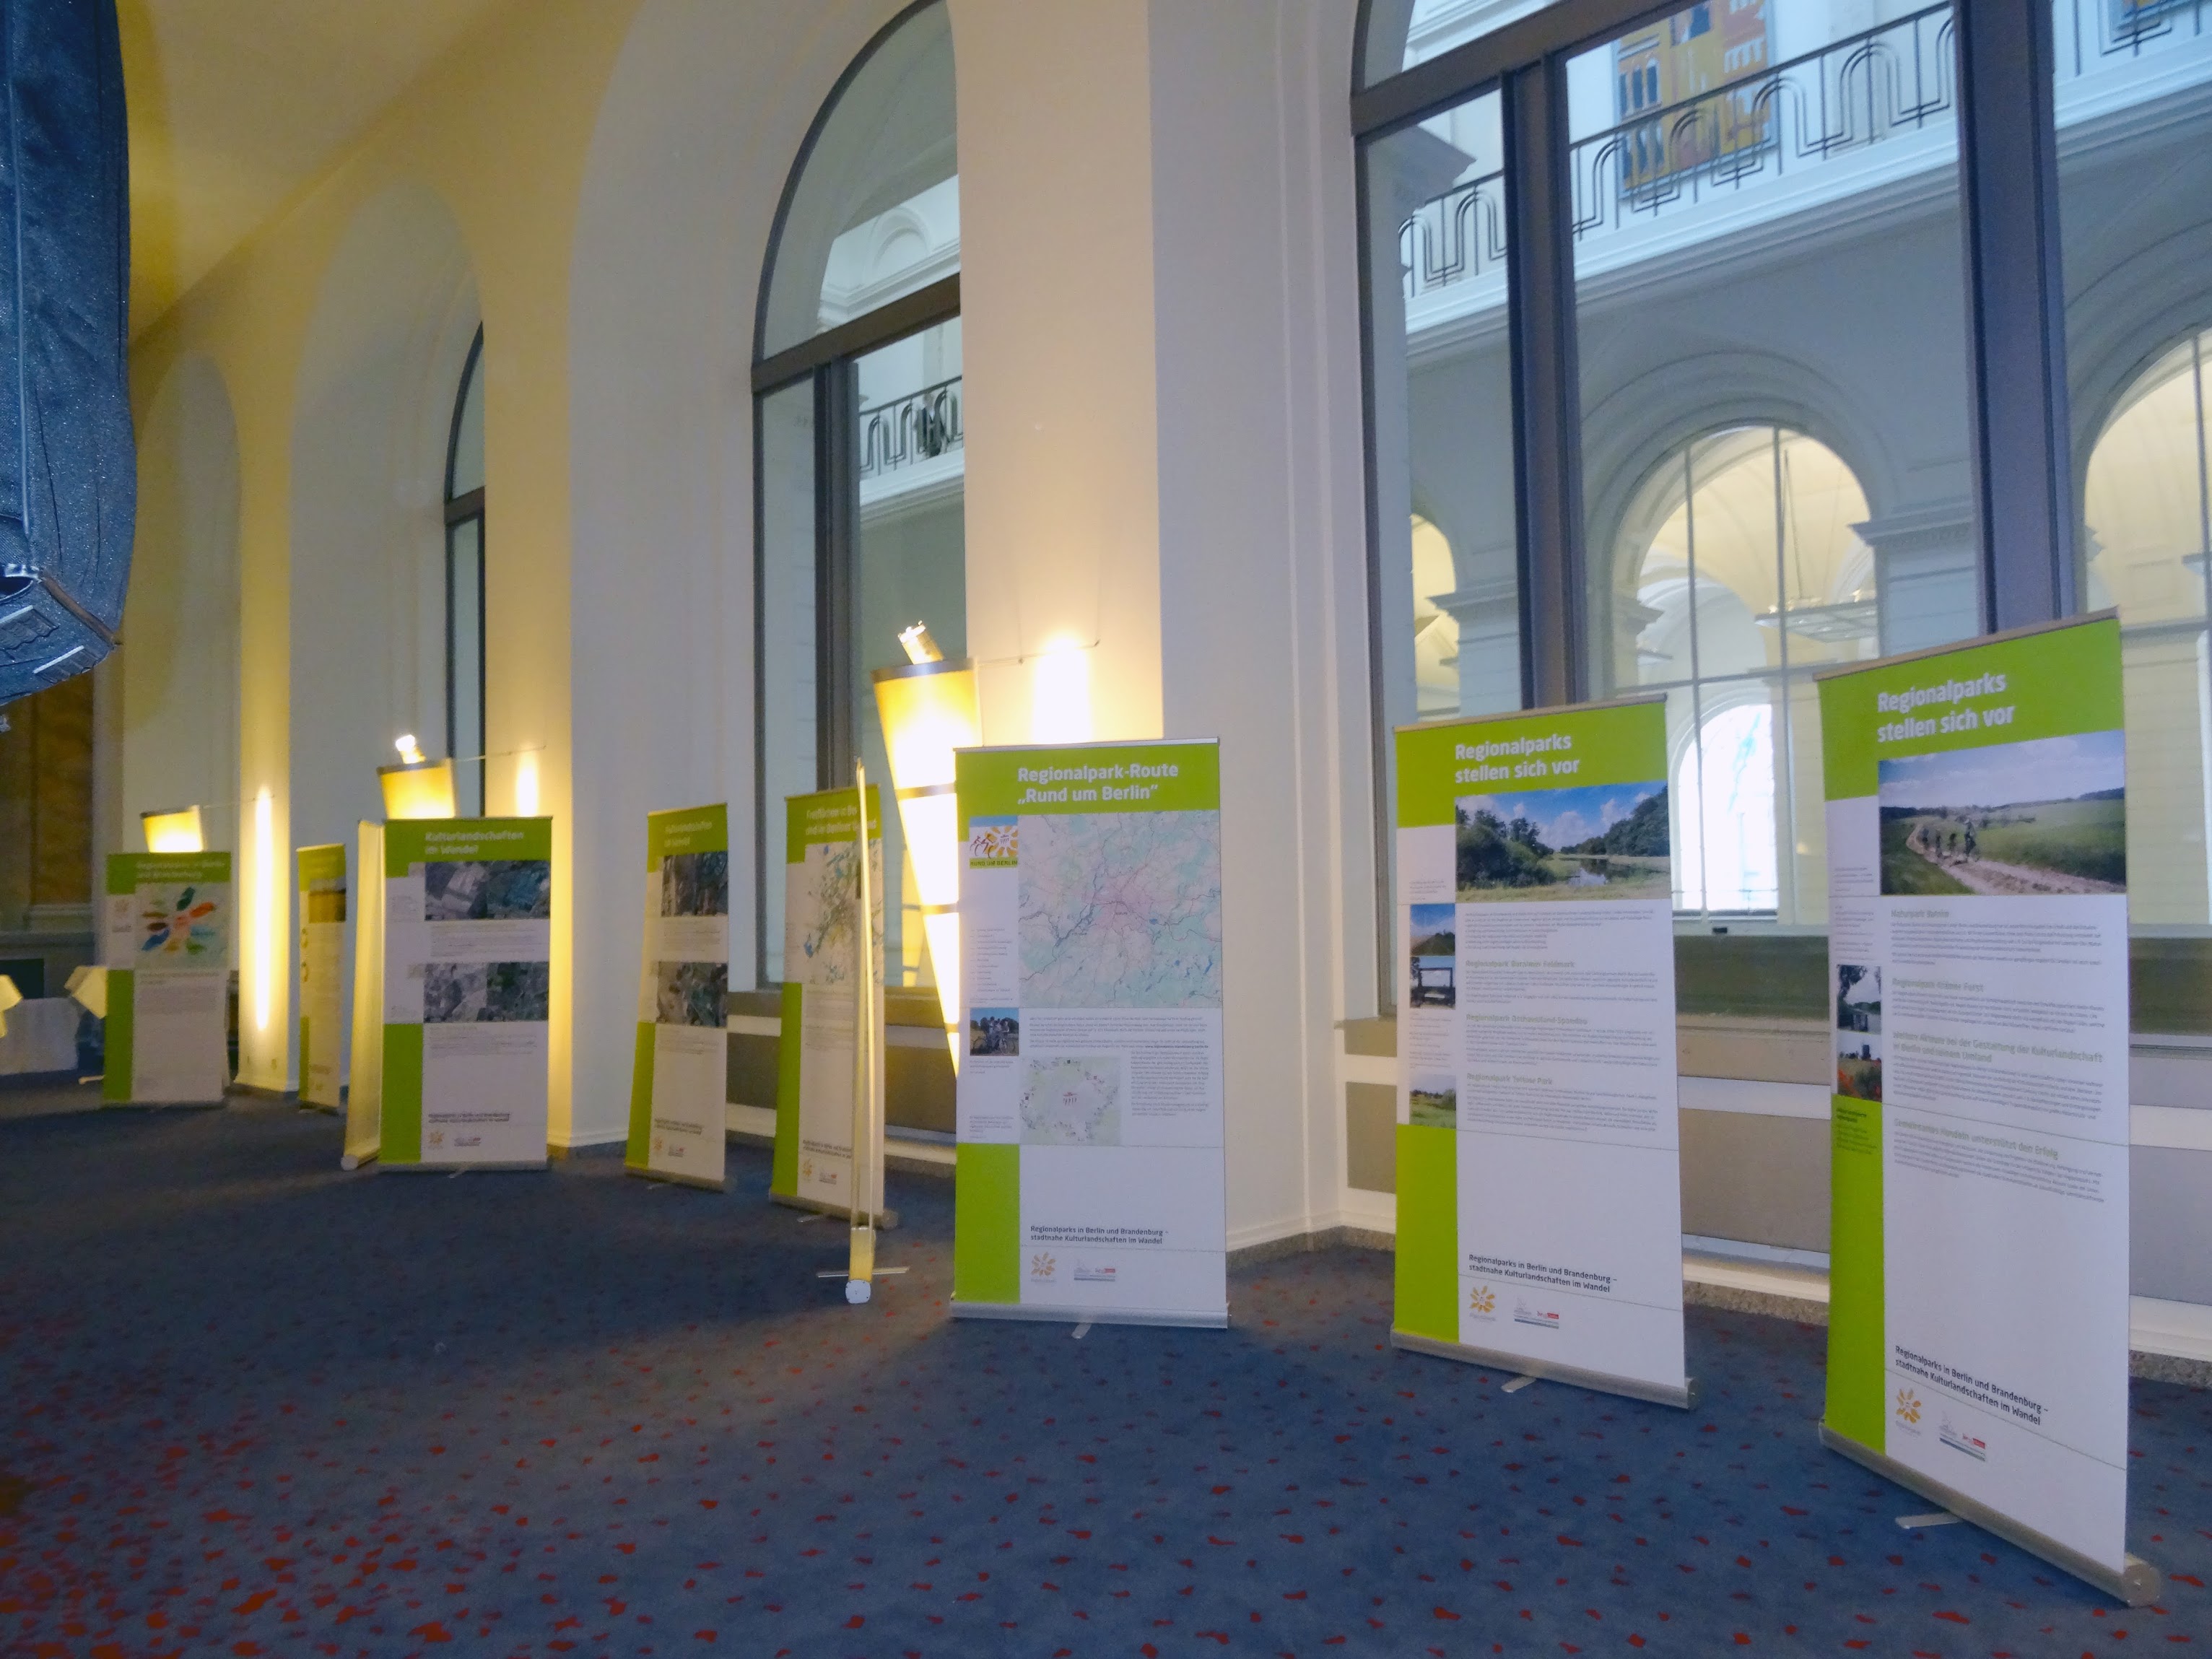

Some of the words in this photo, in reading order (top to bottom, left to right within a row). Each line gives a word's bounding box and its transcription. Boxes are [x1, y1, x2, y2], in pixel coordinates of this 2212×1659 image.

[1877, 673, 2007, 713] Regionalparks
[1877, 717, 1936, 743] stellen
[1941, 709, 1978, 733] sich
[1983, 705, 2016, 726] vor
[1455, 733, 1572, 762] Regionalparks
[1018, 762, 1179, 785] Regionalpark-Route
[1455, 763, 1509, 784] stellen
[1515, 759, 1546, 778] sich
[1551, 758, 1580, 775] vor
[1017, 787, 1067, 805] „Rund
[1073, 786, 1097, 801] um
[1030, 1225, 1076, 1235] Regionalparks
[1120, 1228, 1163, 1237] Brandenburg
[1468, 1254, 1516, 1268] Regionalparks
[1518, 1260, 1525, 1269] in
[1527, 1263, 1547, 1273] Berlin
[1549, 1266, 1562, 1275] und
[1564, 1268, 1611, 1284] Brandenburg
[1468, 1264, 1503, 1276] stadtnahe
[1504, 1269, 1570, 1287] Kulturlandschaften
[1572, 1279, 1581, 1288] im
[1583, 1281, 1610, 1293] Wandel
[1895, 1345, 1942, 1372] Regionalparks
[1943, 1364, 1951, 1375] in
[1951, 1368, 1973, 1385] Berlin
[1974, 1378, 1990, 1391] und
[1992, 1385, 2042, 1414] Brandenburg
[1895, 1359, 1929, 1379] stadtnahe
[1930, 1372, 1999, 1408] Kulturlandschaften
[2000, 1401, 2010, 1412] im
[2012, 1406, 2041, 1426] Wandel
